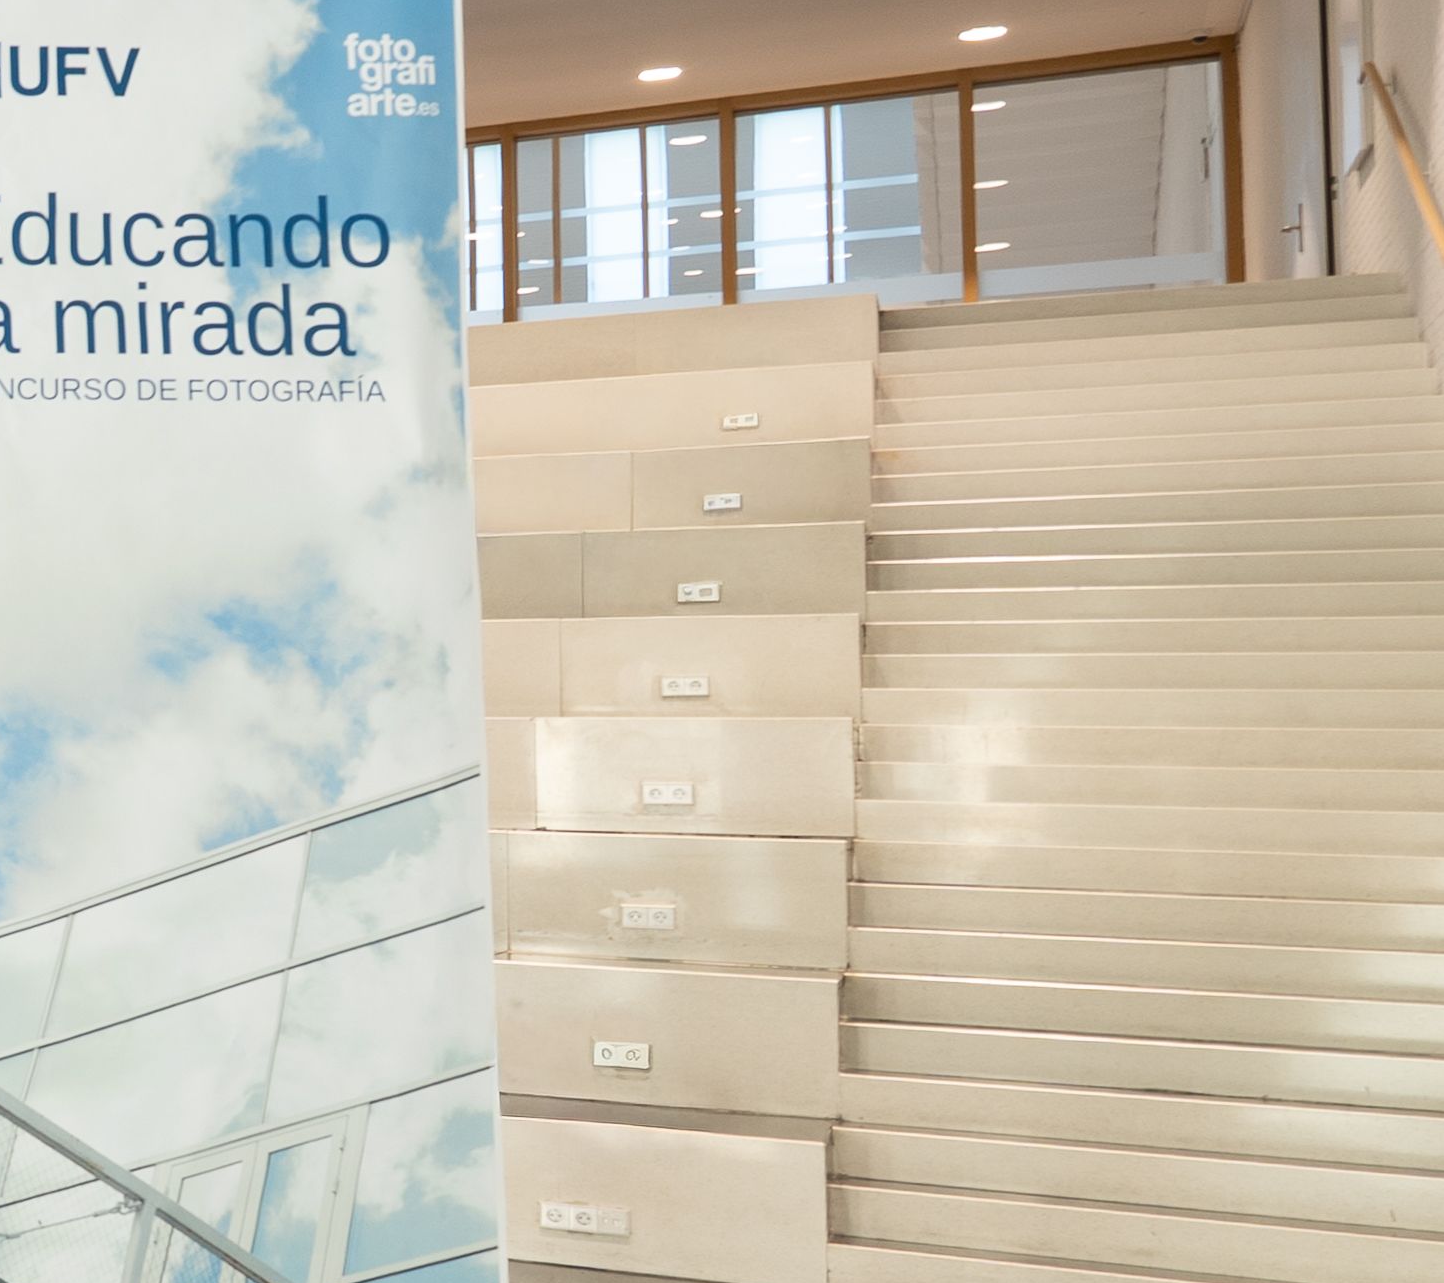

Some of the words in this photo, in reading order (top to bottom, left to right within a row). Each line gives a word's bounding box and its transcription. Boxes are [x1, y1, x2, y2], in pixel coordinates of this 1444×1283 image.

[343, 32, 416, 70] foto
[9, 45, 140, 97] UFV
[359, 55, 436, 91] grafi
[54, 282, 356, 357] mirada
[137, 378, 178, 402] DE
[188, 375, 387, 404] FOTOGRAFÍA
